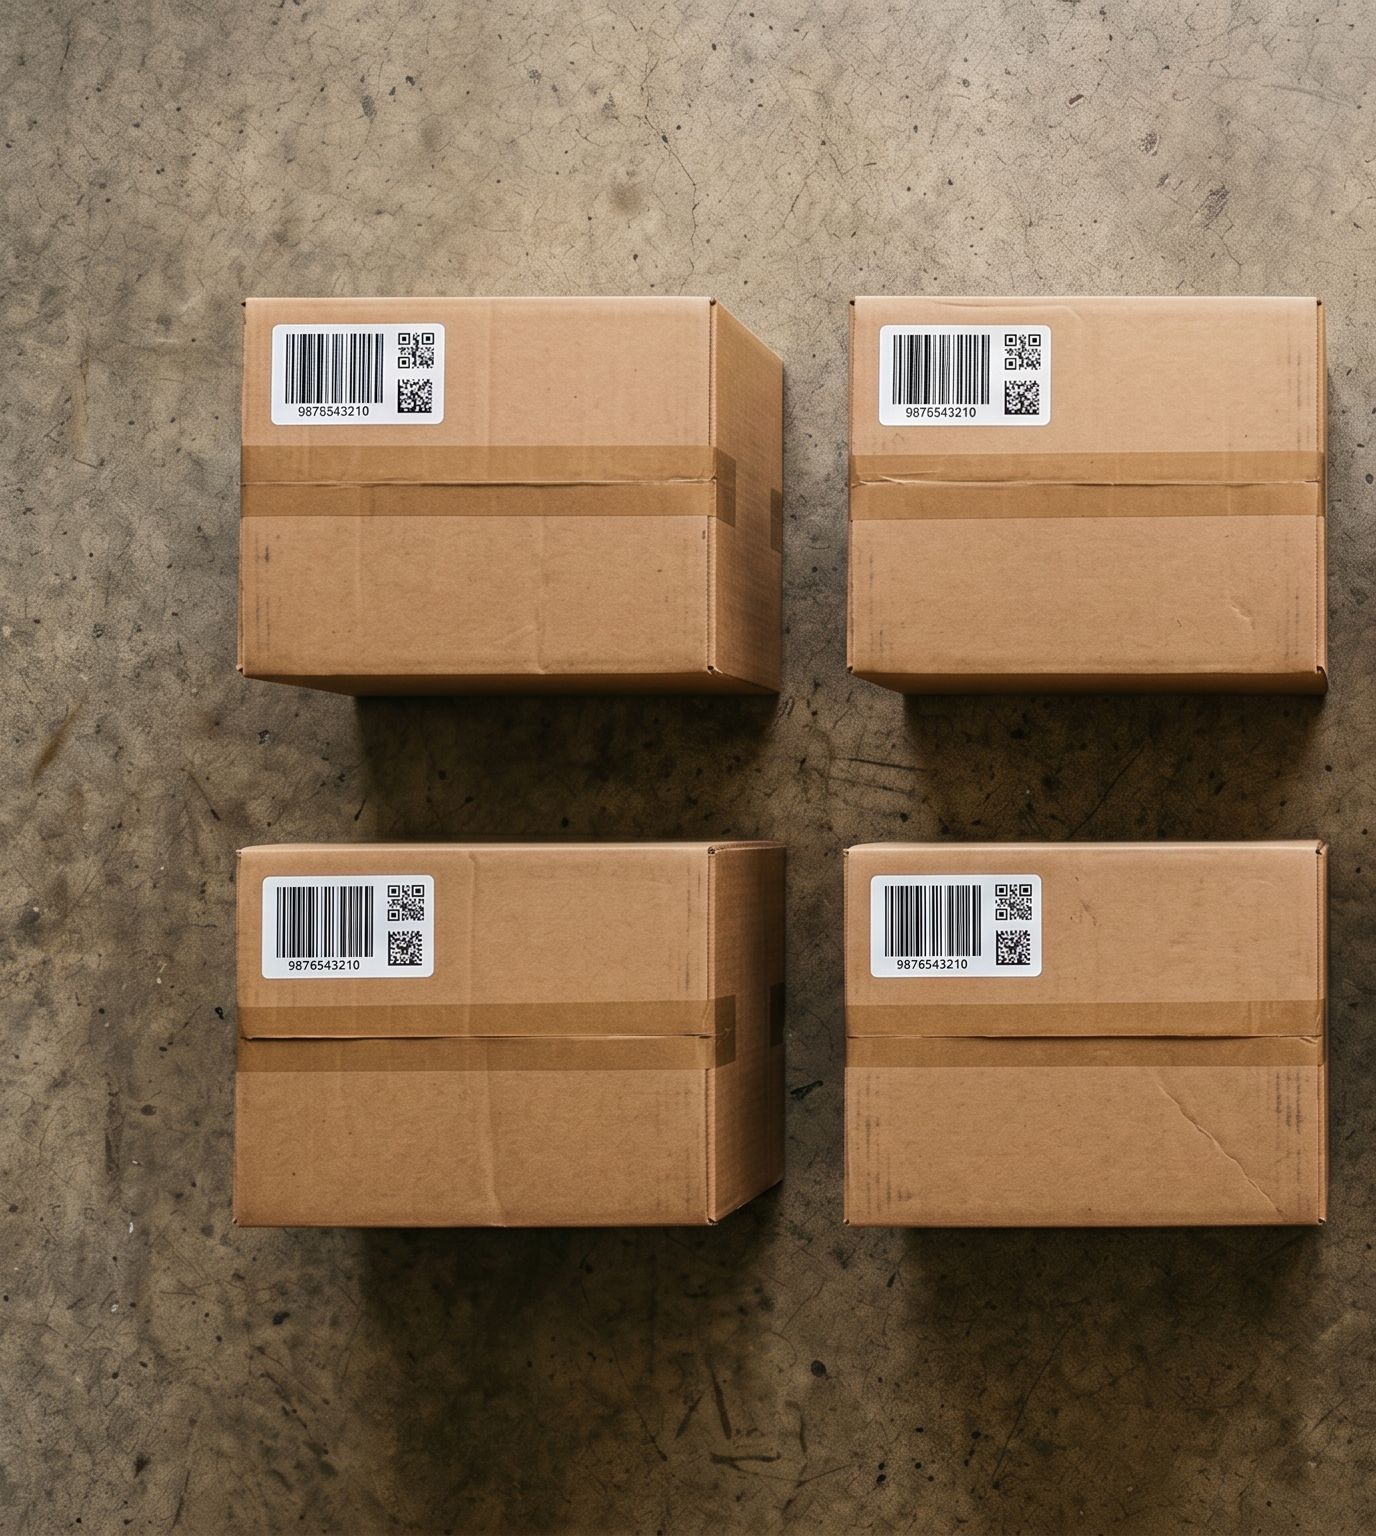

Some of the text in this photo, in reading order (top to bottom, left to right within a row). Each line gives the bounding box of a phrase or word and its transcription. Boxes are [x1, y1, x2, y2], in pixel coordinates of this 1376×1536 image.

[905, 406, 977, 418] 9876543210
[288, 959, 360, 971] 9876543210
[896, 958, 968, 970] 9876543210
